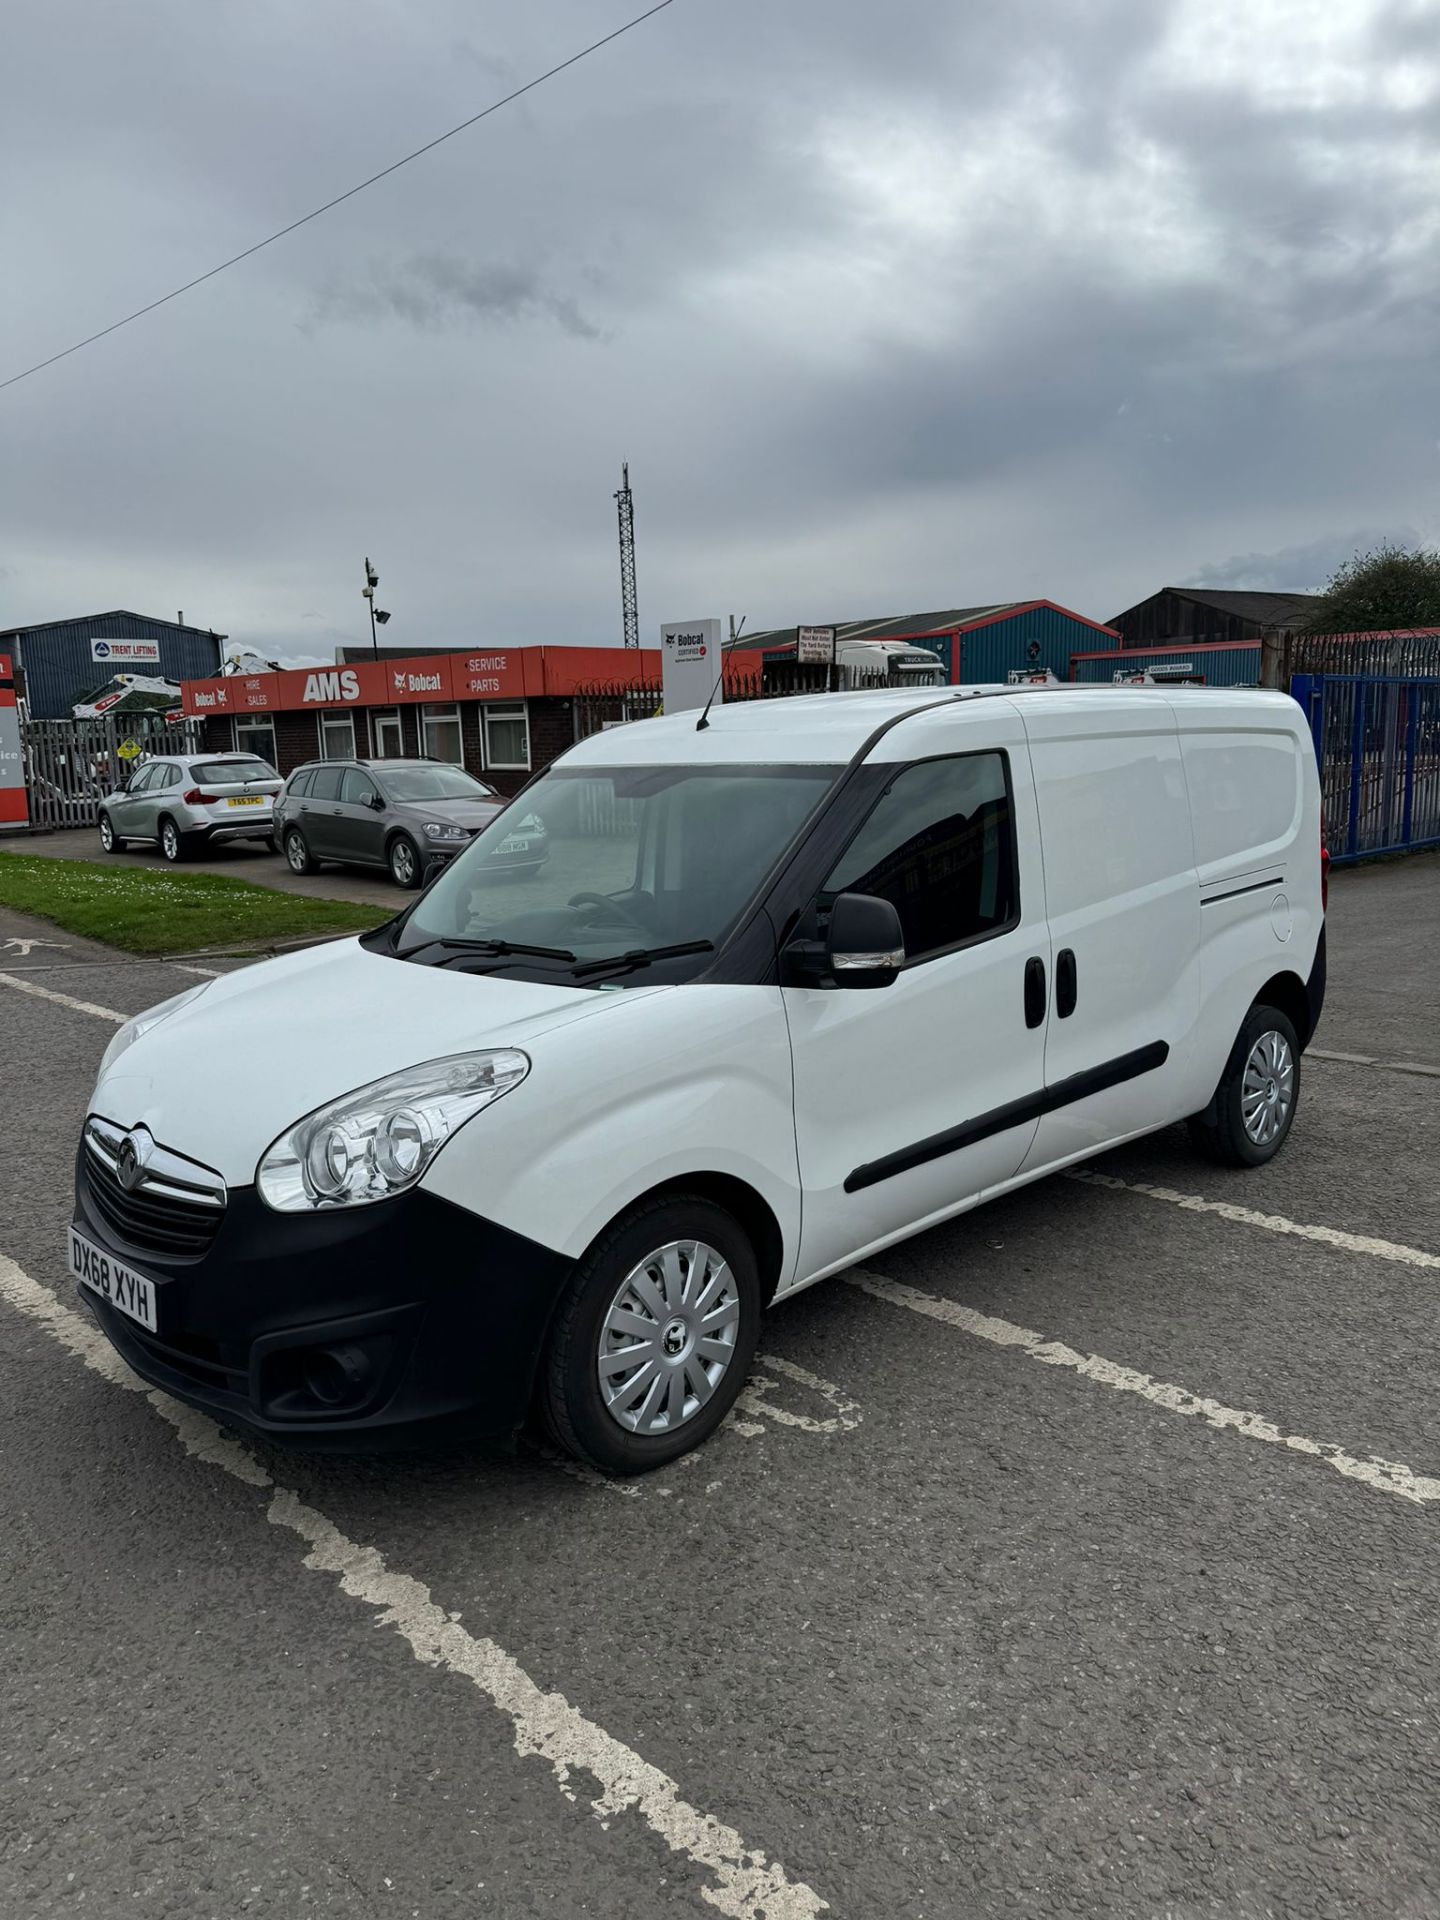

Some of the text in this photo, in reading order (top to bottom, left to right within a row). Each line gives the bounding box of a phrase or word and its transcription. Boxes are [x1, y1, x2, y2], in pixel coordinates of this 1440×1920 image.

[677, 632, 704, 646] Bobcat
[111, 645, 157, 655] TRENT LIFTING
[469, 656, 507, 672] SERVICE
[246, 679, 261, 690] HIRE
[303, 670, 360, 702] AMS
[408, 672, 441, 692] Bobcat
[471, 679, 500, 692] PARTS
[195, 691, 216, 707] Bobcat
[248, 695, 267, 706] SALES
[72, 1236, 149, 1322] DX68 XYH
